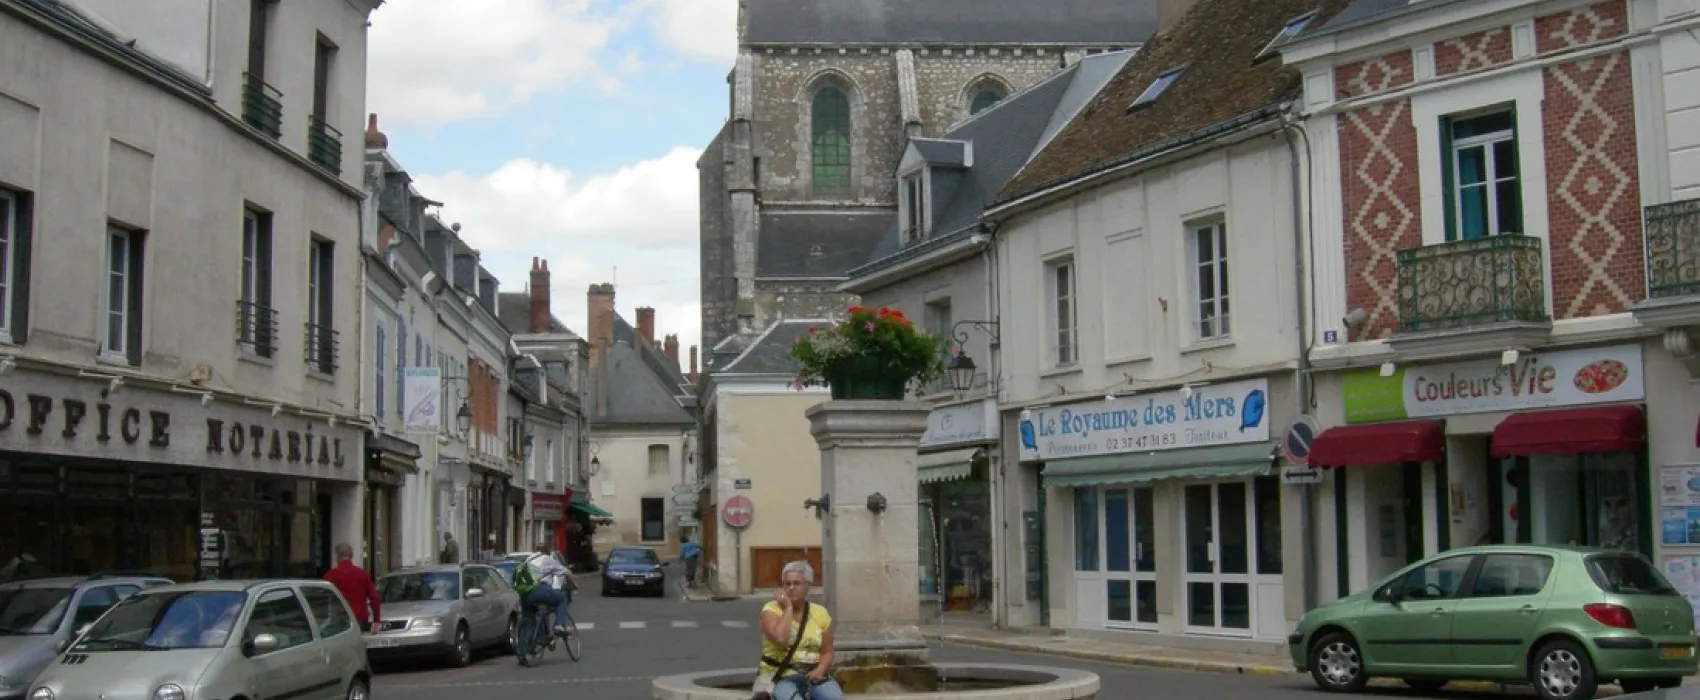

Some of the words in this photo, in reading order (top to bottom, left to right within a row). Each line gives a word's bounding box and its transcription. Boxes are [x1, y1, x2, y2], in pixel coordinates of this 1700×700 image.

[1414, 373, 1502, 402] Couleurs
[1509, 357, 1556, 397] Vie
[1038, 411, 1056, 436] Le
[1060, 408, 1138, 438] Royaume
[1143, 397, 1177, 426] des
[1183, 391, 1236, 422] Mers
[206, 418, 345, 468] NOTARIAL
[1106, 437, 1119, 450] 02
[1121, 437, 1133, 448] 37
[1135, 435, 1148, 448] 47
[1161, 431, 1177, 445] 83
